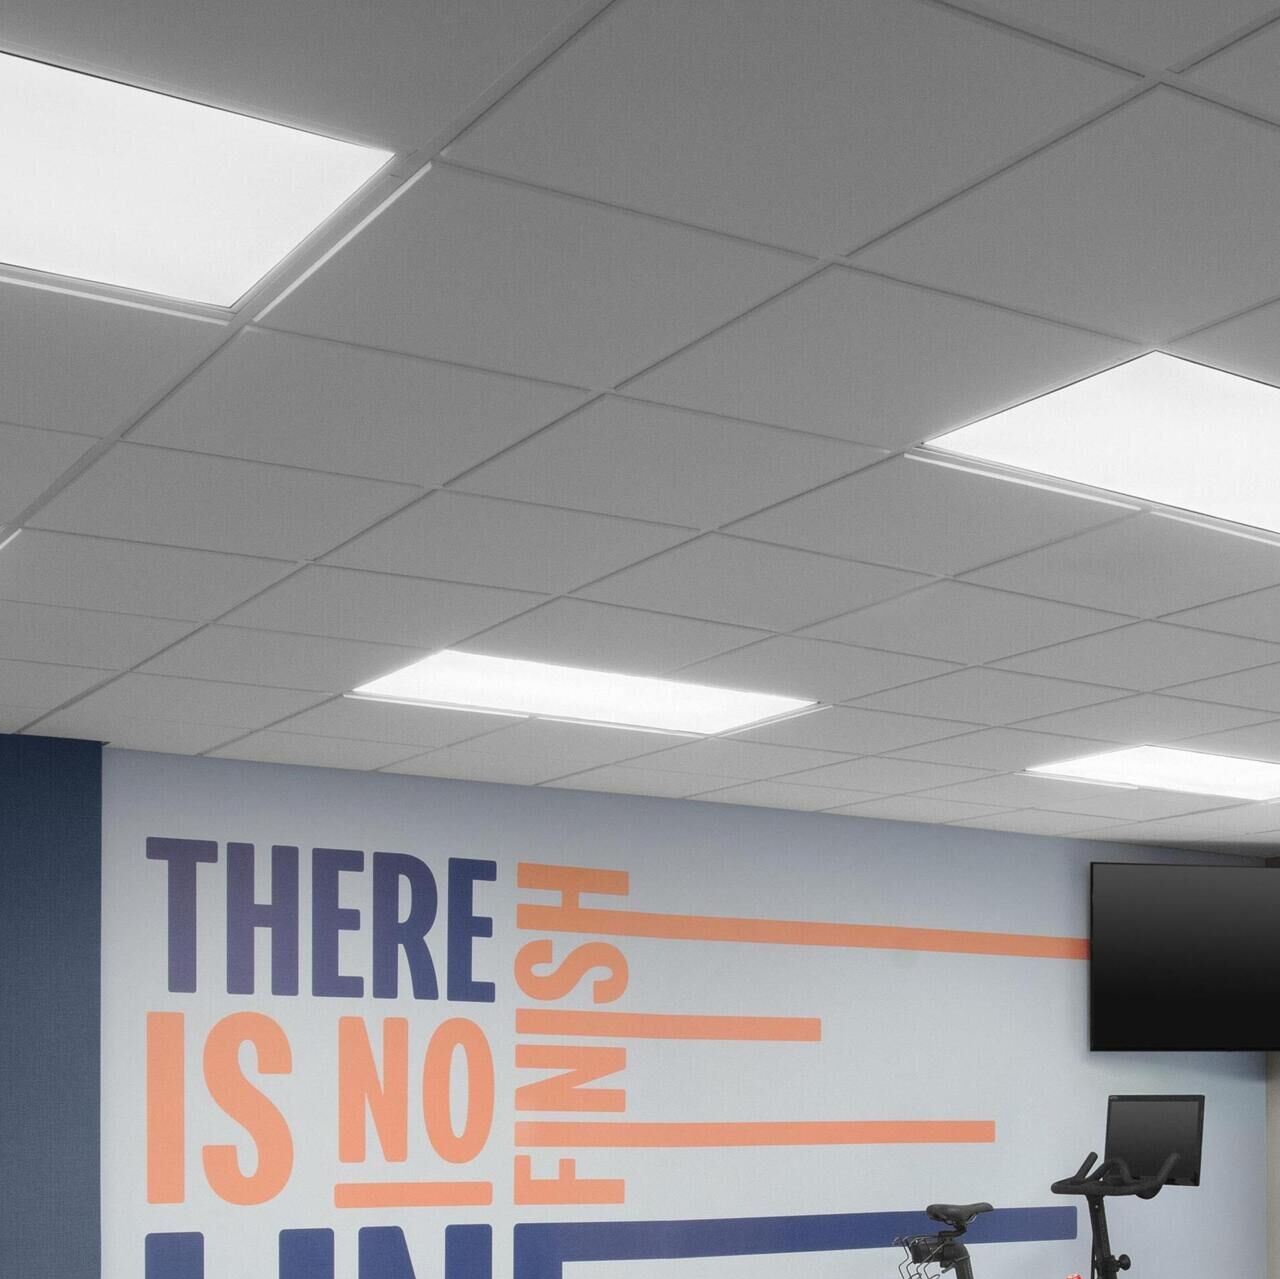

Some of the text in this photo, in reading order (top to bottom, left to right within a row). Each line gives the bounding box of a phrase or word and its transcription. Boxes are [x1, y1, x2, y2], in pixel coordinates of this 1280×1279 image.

[145, 836, 497, 1003] THERE
[146, 1011, 495, 1206] IS NO
